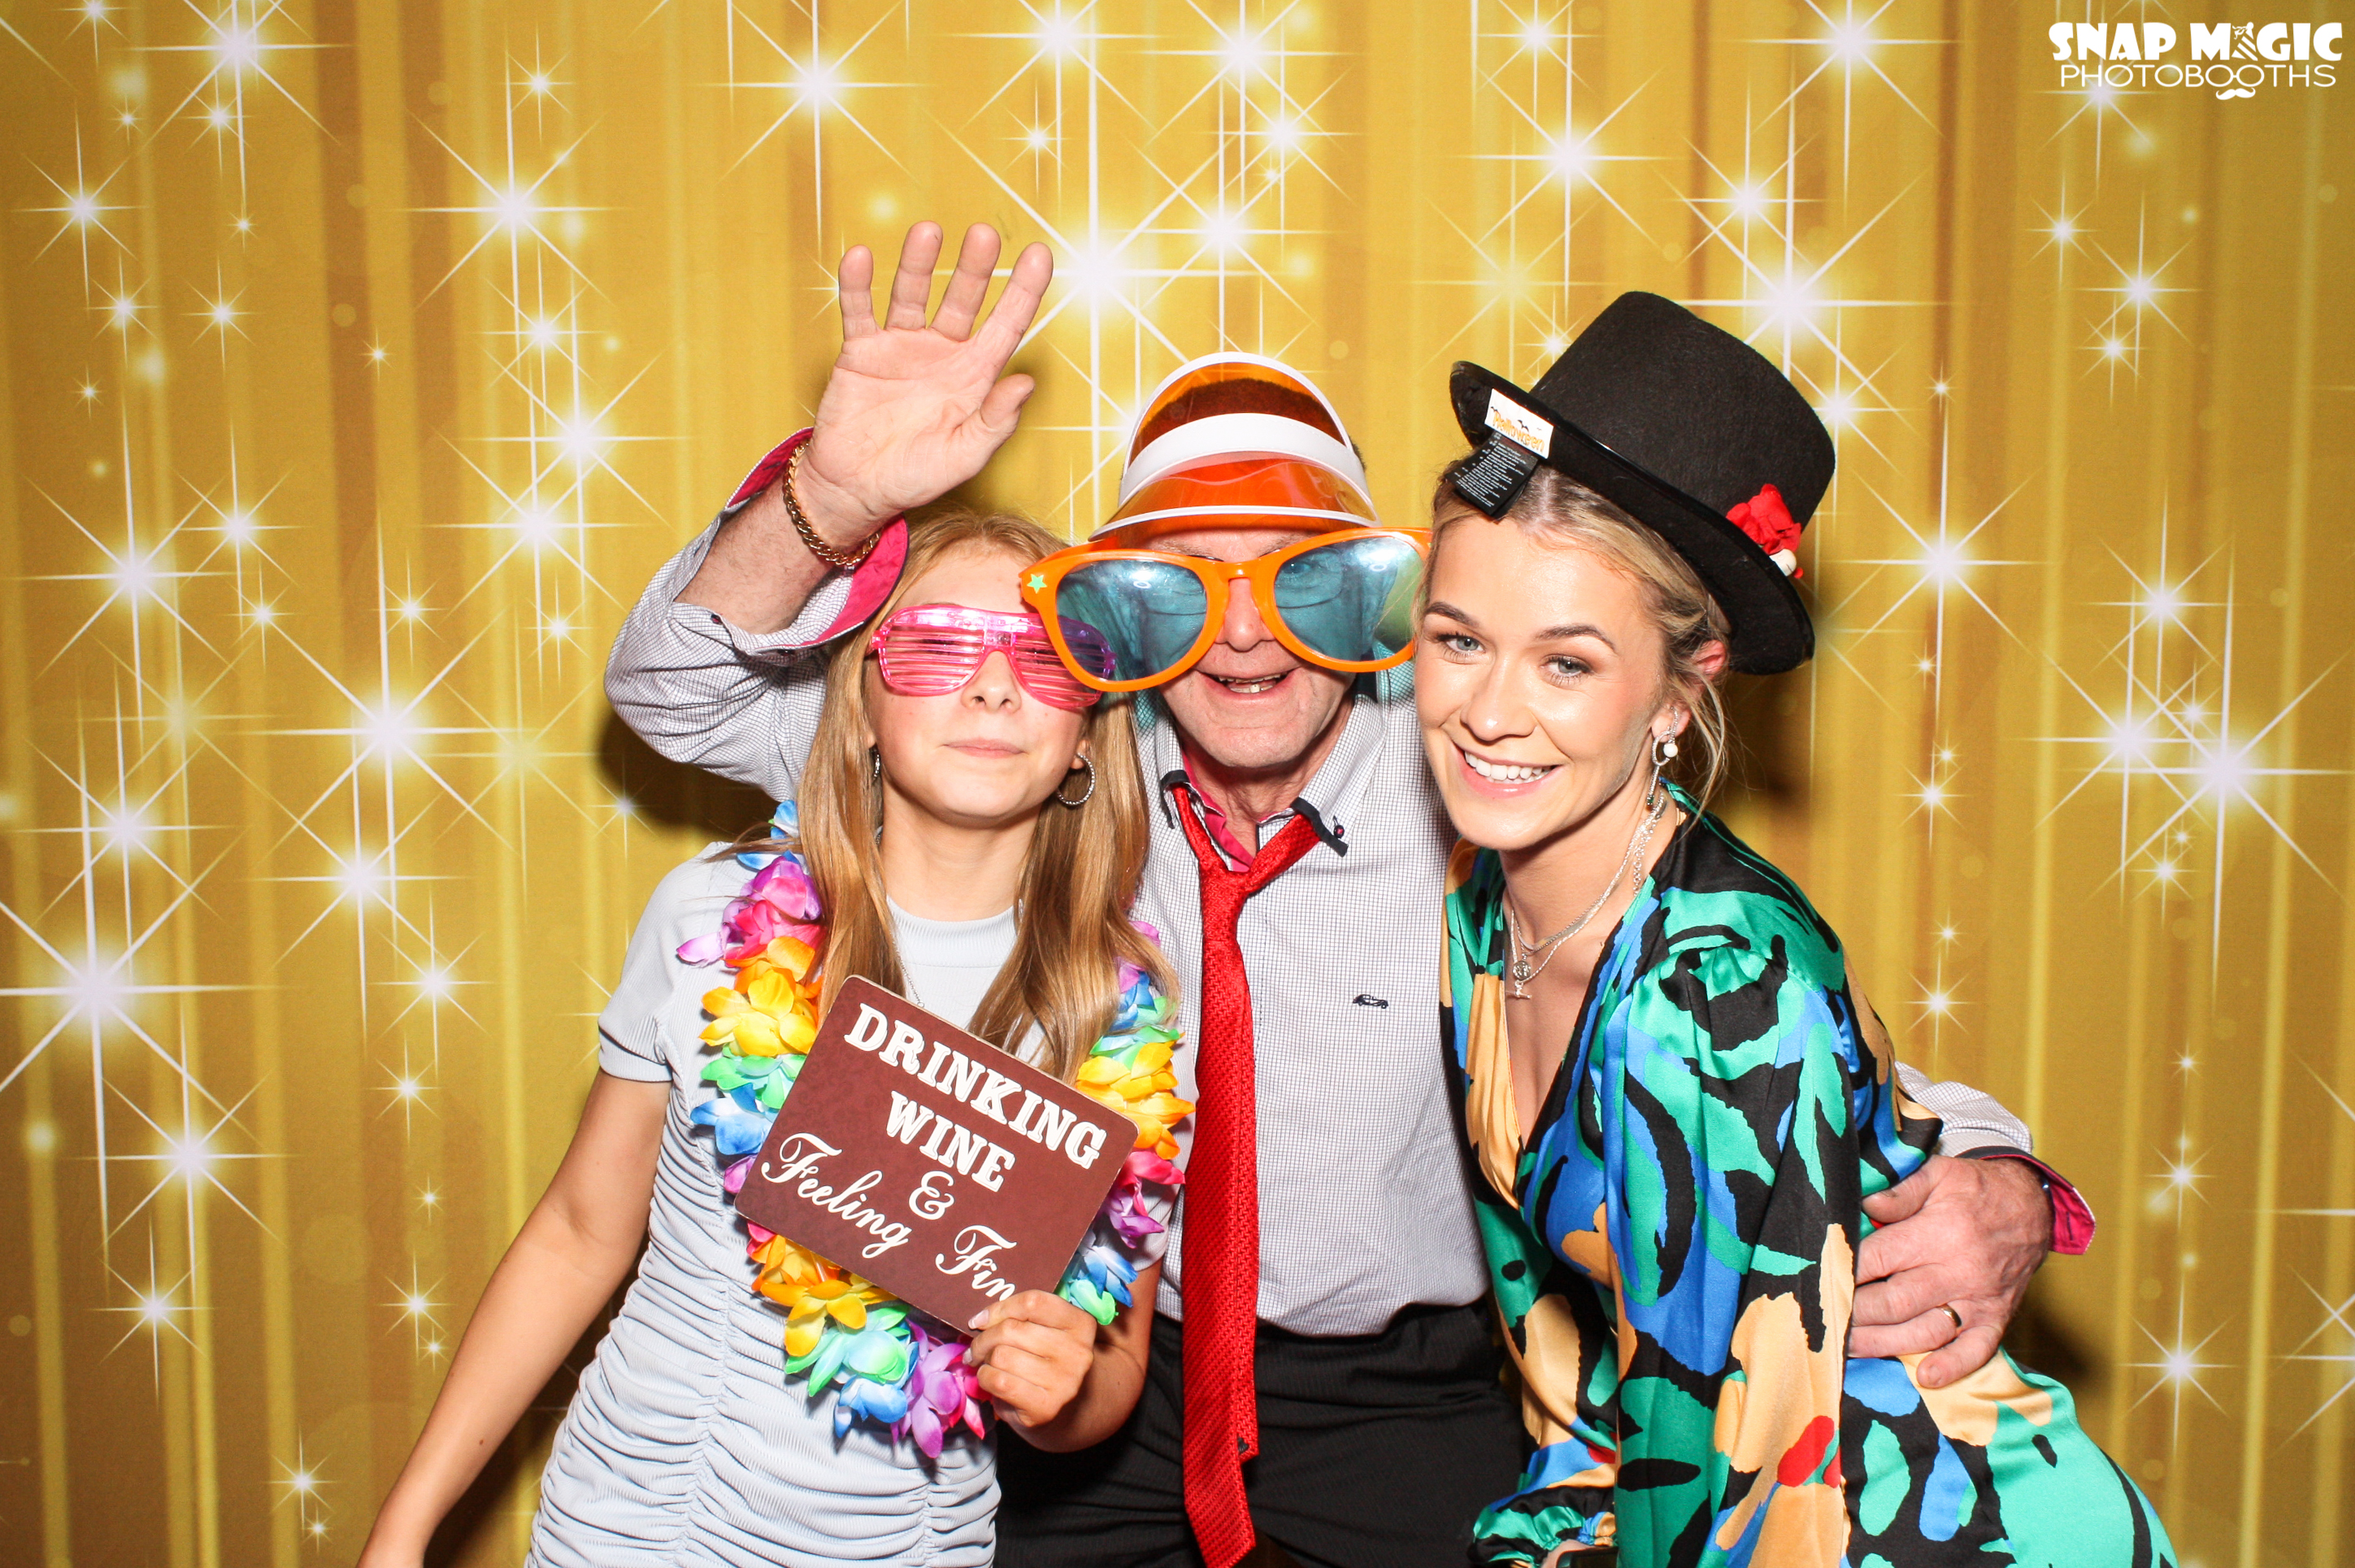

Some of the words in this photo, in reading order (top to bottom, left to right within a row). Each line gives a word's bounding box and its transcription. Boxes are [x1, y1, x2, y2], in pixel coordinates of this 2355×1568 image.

[844, 1002, 1106, 1170] DRINKING
[886, 1090, 1016, 1192] WINE
[761, 1132, 912, 1259] Feeling
[935, 1223, 1017, 1301] Fin
[908, 1170, 955, 1221] &
